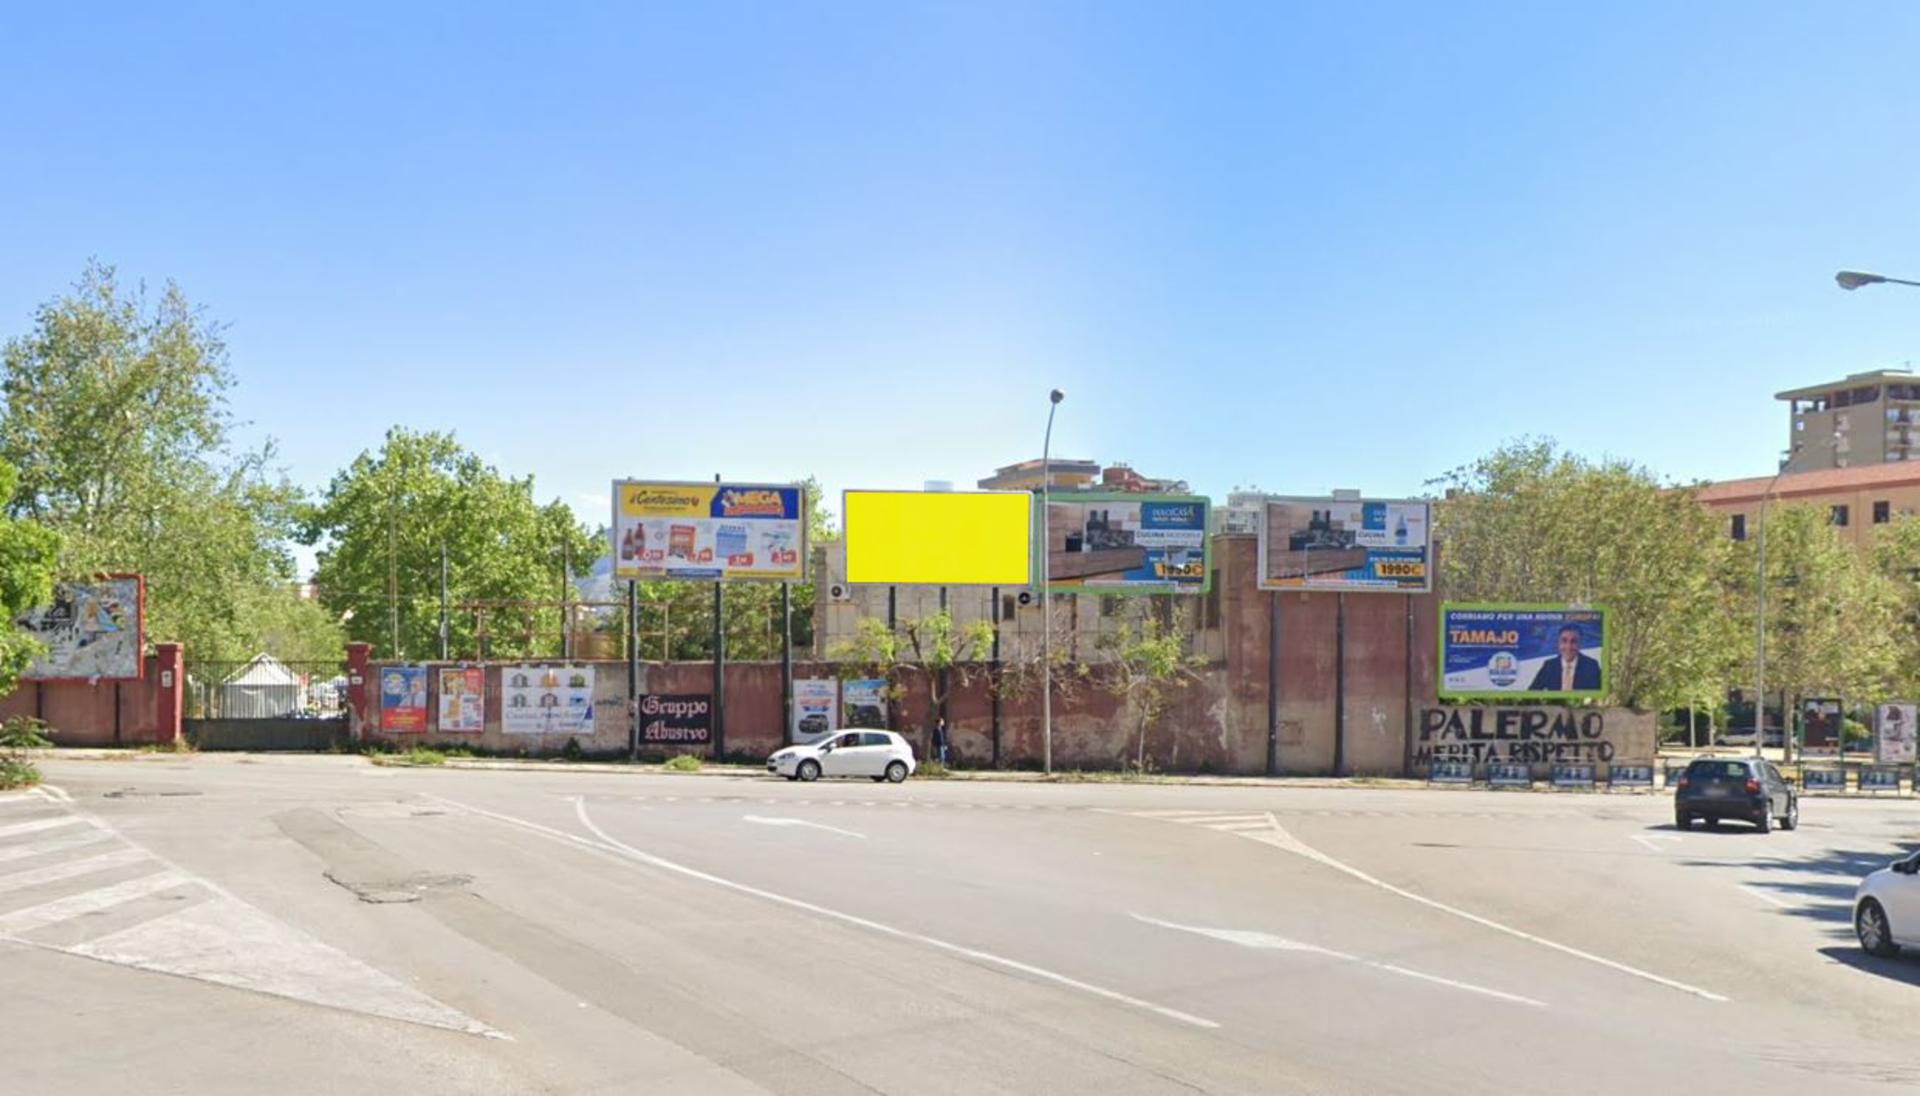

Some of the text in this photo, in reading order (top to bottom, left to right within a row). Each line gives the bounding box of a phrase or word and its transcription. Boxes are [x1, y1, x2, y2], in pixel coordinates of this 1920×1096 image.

[1496, 612, 1514, 621] PER
[1449, 630, 1520, 645] TAMAJO
[641, 695, 709, 719] Gruppo
[1419, 708, 1604, 741] PALERMO
[1413, 740, 1615, 766] MERITA RISPETTO
